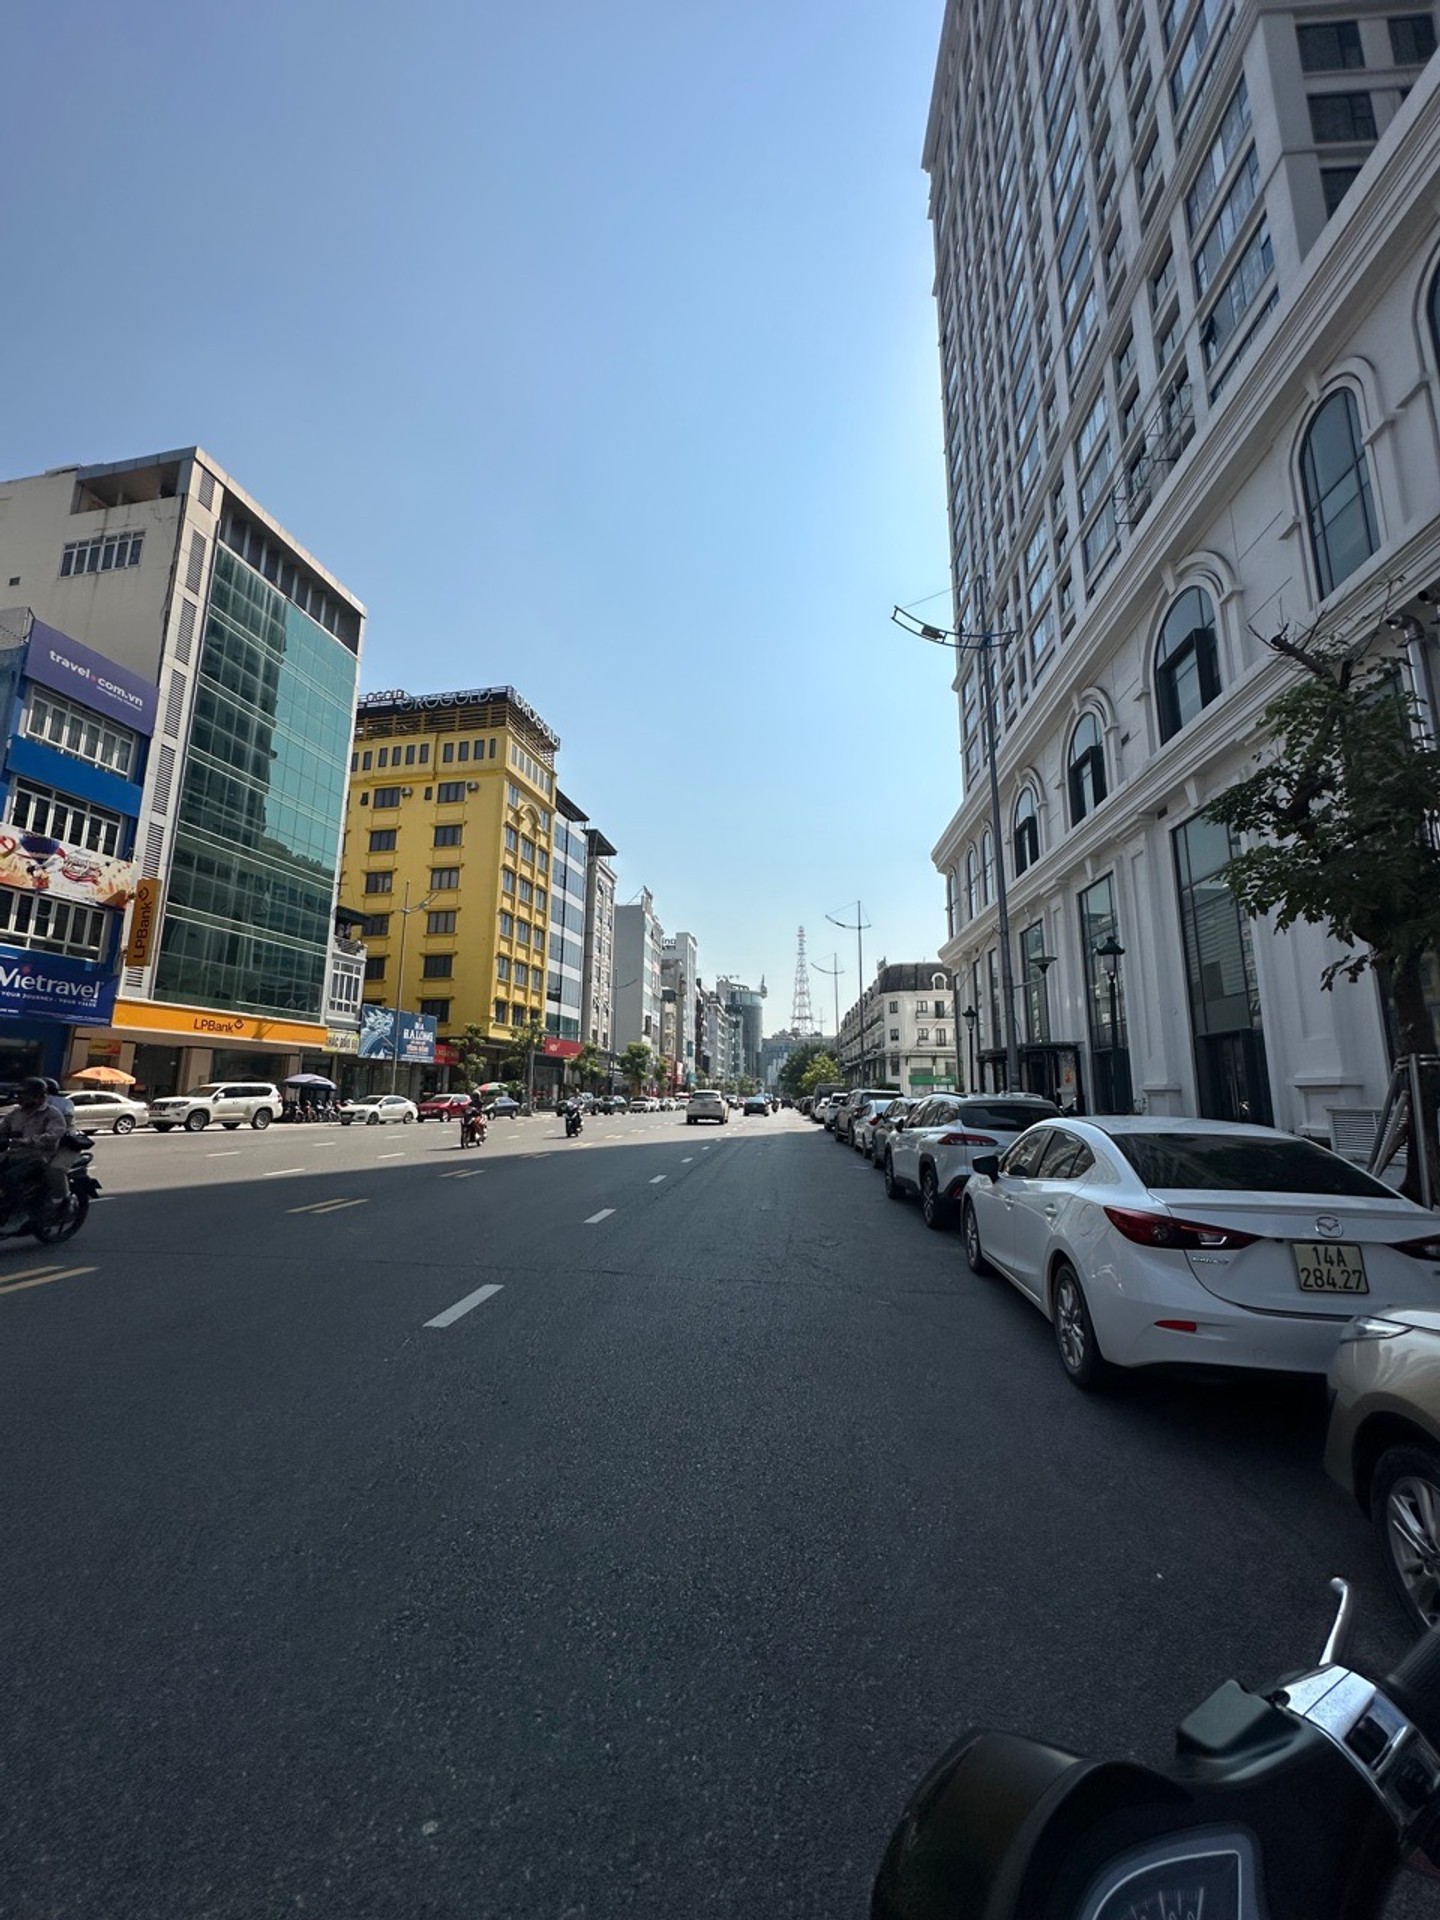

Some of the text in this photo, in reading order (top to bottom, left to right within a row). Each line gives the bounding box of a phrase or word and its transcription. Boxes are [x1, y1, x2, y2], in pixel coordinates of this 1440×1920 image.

[134, 901, 153, 959] LPBank
[0, 964, 100, 999] Vietravel
[194, 1018, 234, 1034] LPBank
[1312, 1246, 1348, 1268] 14A
[1301, 1267, 1363, 1291] 284.27
